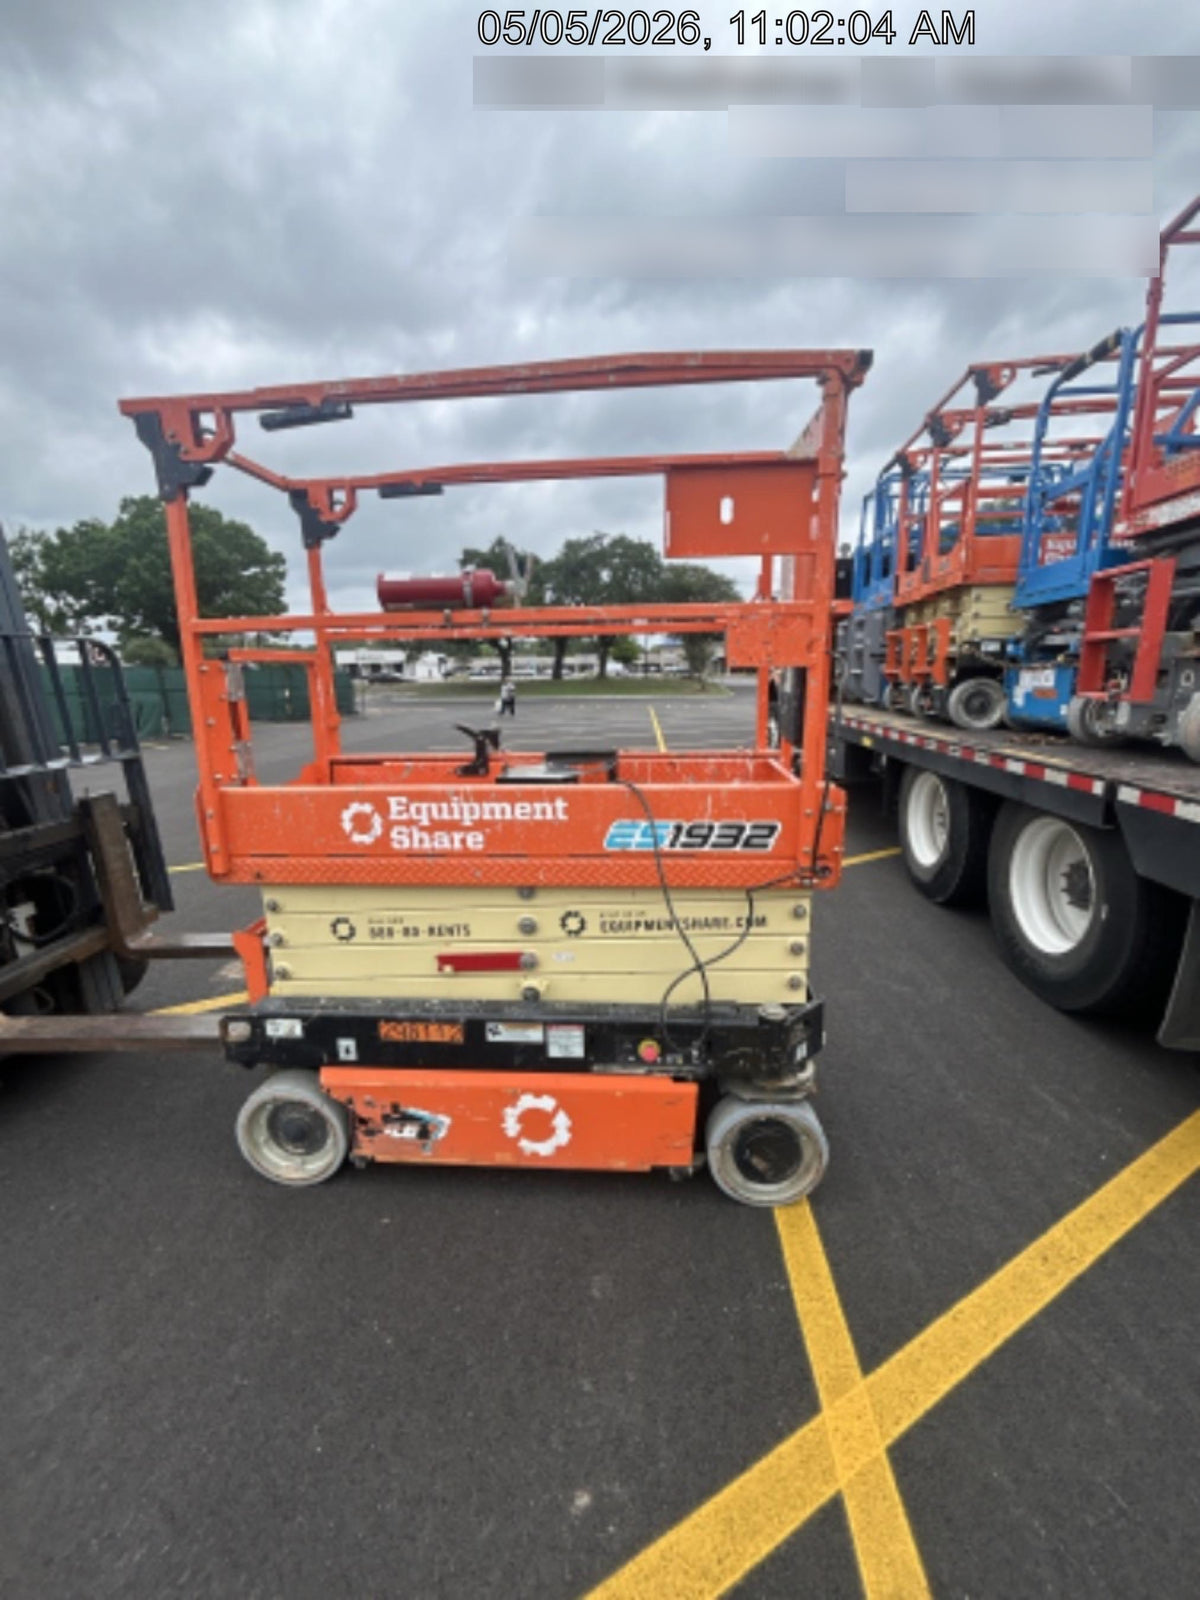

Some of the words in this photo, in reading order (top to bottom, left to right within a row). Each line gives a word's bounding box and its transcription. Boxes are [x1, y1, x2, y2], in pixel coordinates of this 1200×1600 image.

[388, 797, 569, 826] Equipment
[389, 826, 484, 850] Share
[603, 819, 782, 853] ES1932
[600, 915, 768, 934] EQUIPMENSHARE.CM
